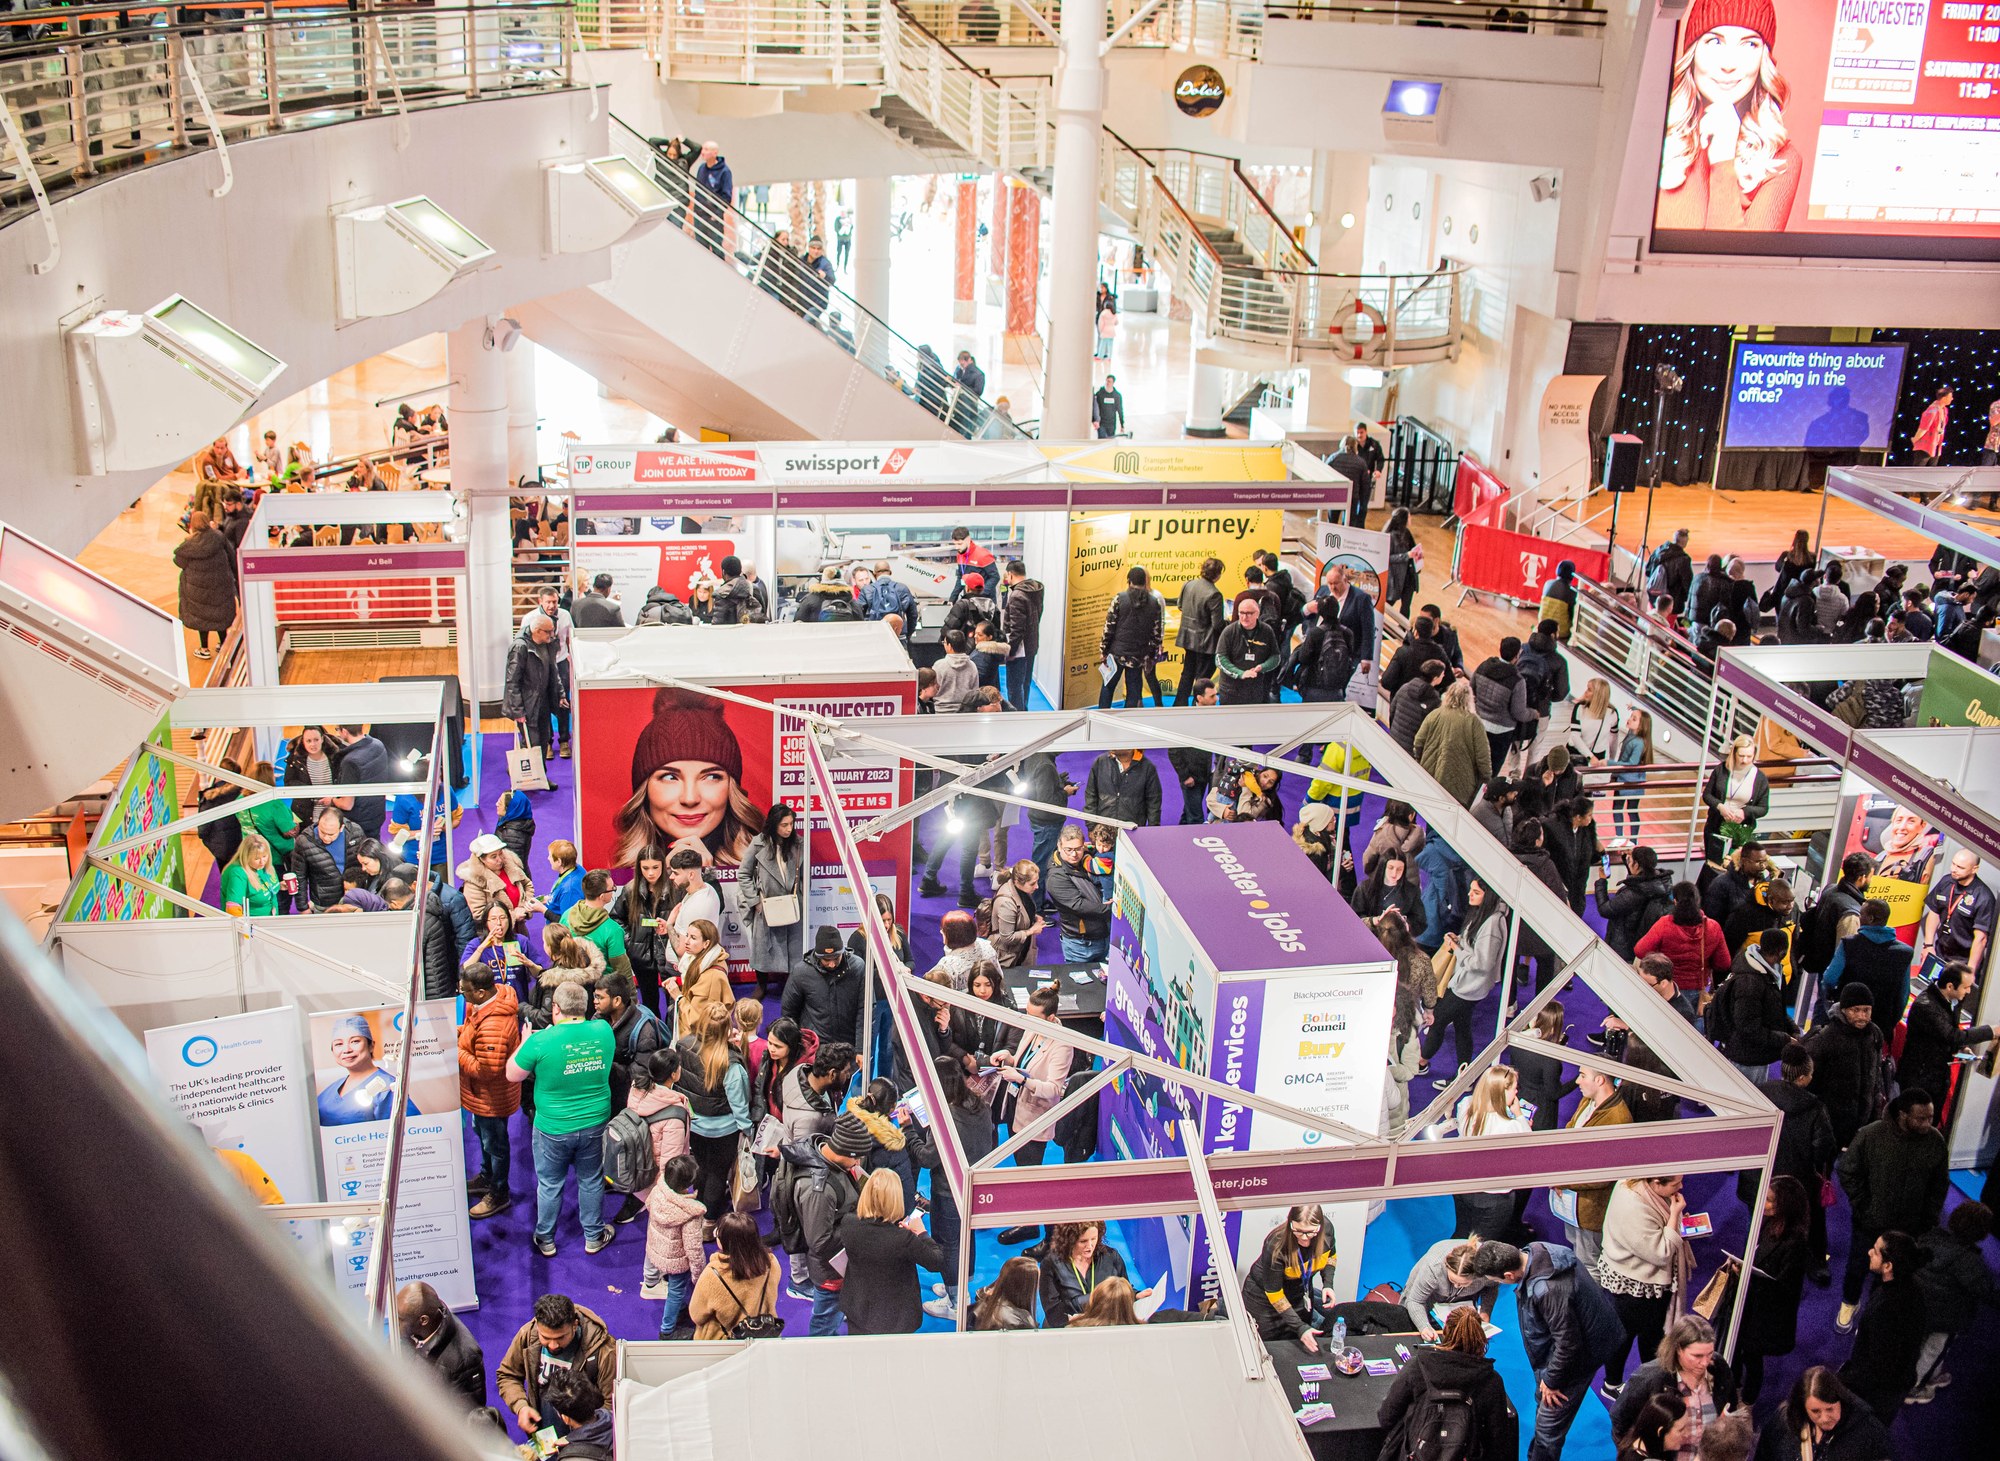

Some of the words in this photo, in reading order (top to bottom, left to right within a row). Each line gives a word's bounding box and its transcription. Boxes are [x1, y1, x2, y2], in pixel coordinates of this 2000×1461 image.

[1839, 0, 1925, 25] MANCHESTER
[1941, 2, 1984, 19] FRIDAY
[1968, 25, 2000, 42] 11:00
[1924, 60, 1984, 78] SATURDAY
[1177, 80, 1222, 96] Dolci
[1743, 350, 1804, 367] Favourite
[1808, 352, 1842, 371] thing
[1846, 353, 1885, 368] about
[1740, 370, 1764, 385] not
[1766, 370, 1803, 388] going
[1808, 371, 1819, 385] in
[1824, 371, 1846, 386] the
[1738, 388, 1783, 403] office?
[576, 461, 590, 469] TIP
[595, 461, 632, 470] GROUP
[658, 456, 674, 466] WE
[676, 455, 695, 466] ARE
[785, 454, 880, 474] swissport
[1143, 464, 1166, 472] Greater
[1167, 464, 1204, 472] Manchester
[1144, 457, 1170, 465] Transport
[1172, 456, 1184, 464] for
[641, 469, 664, 478] JOIN
[666, 468, 687, 478] OUR
[689, 468, 715, 477] TEAM
[717, 468, 748, 477] TODAY
[882, 496, 913, 504] Swissport
[1233, 493, 1260, 501] Transport
[1154, 518, 1255, 541] journey.
[1074, 546, 1097, 559] Join
[1100, 543, 1118, 554] our
[1140, 550, 1172, 558] current
[1174, 549, 1217, 558] vacancies
[246, 562, 255, 570] 26
[905, 563, 936, 578] swissport
[1080, 558, 1124, 577] journey.
[1152, 561, 1179, 570] future
[1181, 561, 1196, 572] job
[1799, 714, 1816, 731] London
[783, 773, 795, 783] 20
[867, 770, 890, 780] 2023
[786, 799, 814, 808] BAE
[1892, 775, 1911, 791] Greater
[1911, 786, 1941, 811] Manchester
[1941, 805, 1951, 819] Fire
[1952, 814, 1962, 826] and
[1963, 820, 1984, 840] Rescue
[1302, 1012, 1346, 1023] Bolton
[1301, 1022, 1346, 1033] Council
[221, 1042, 242, 1050] Health
[243, 1038, 263, 1046] Group
[1298, 1041, 1345, 1058] Bury
[566, 1060, 602, 1070] DEVELOPING
[584, 1063, 606, 1072] PEOPLE
[169, 1083, 187, 1092] The
[188, 1078, 209, 1088] UK's
[211, 1072, 244, 1084] leading
[244, 1064, 283, 1080] provider
[1284, 1073, 1324, 1085] GMCA
[180, 1084, 237, 1101] independent
[238, 1075, 286, 1089] healthcare
[199, 1092, 248, 1107] nationwide
[249, 1084, 287, 1096] network
[186, 1111, 195, 1120] of
[197, 1105, 237, 1118] hospitals
[247, 1096, 274, 1107] clinics
[335, 1133, 367, 1145] Circle
[408, 1125, 443, 1136] Group
[978, 1193, 994, 1204] 30
